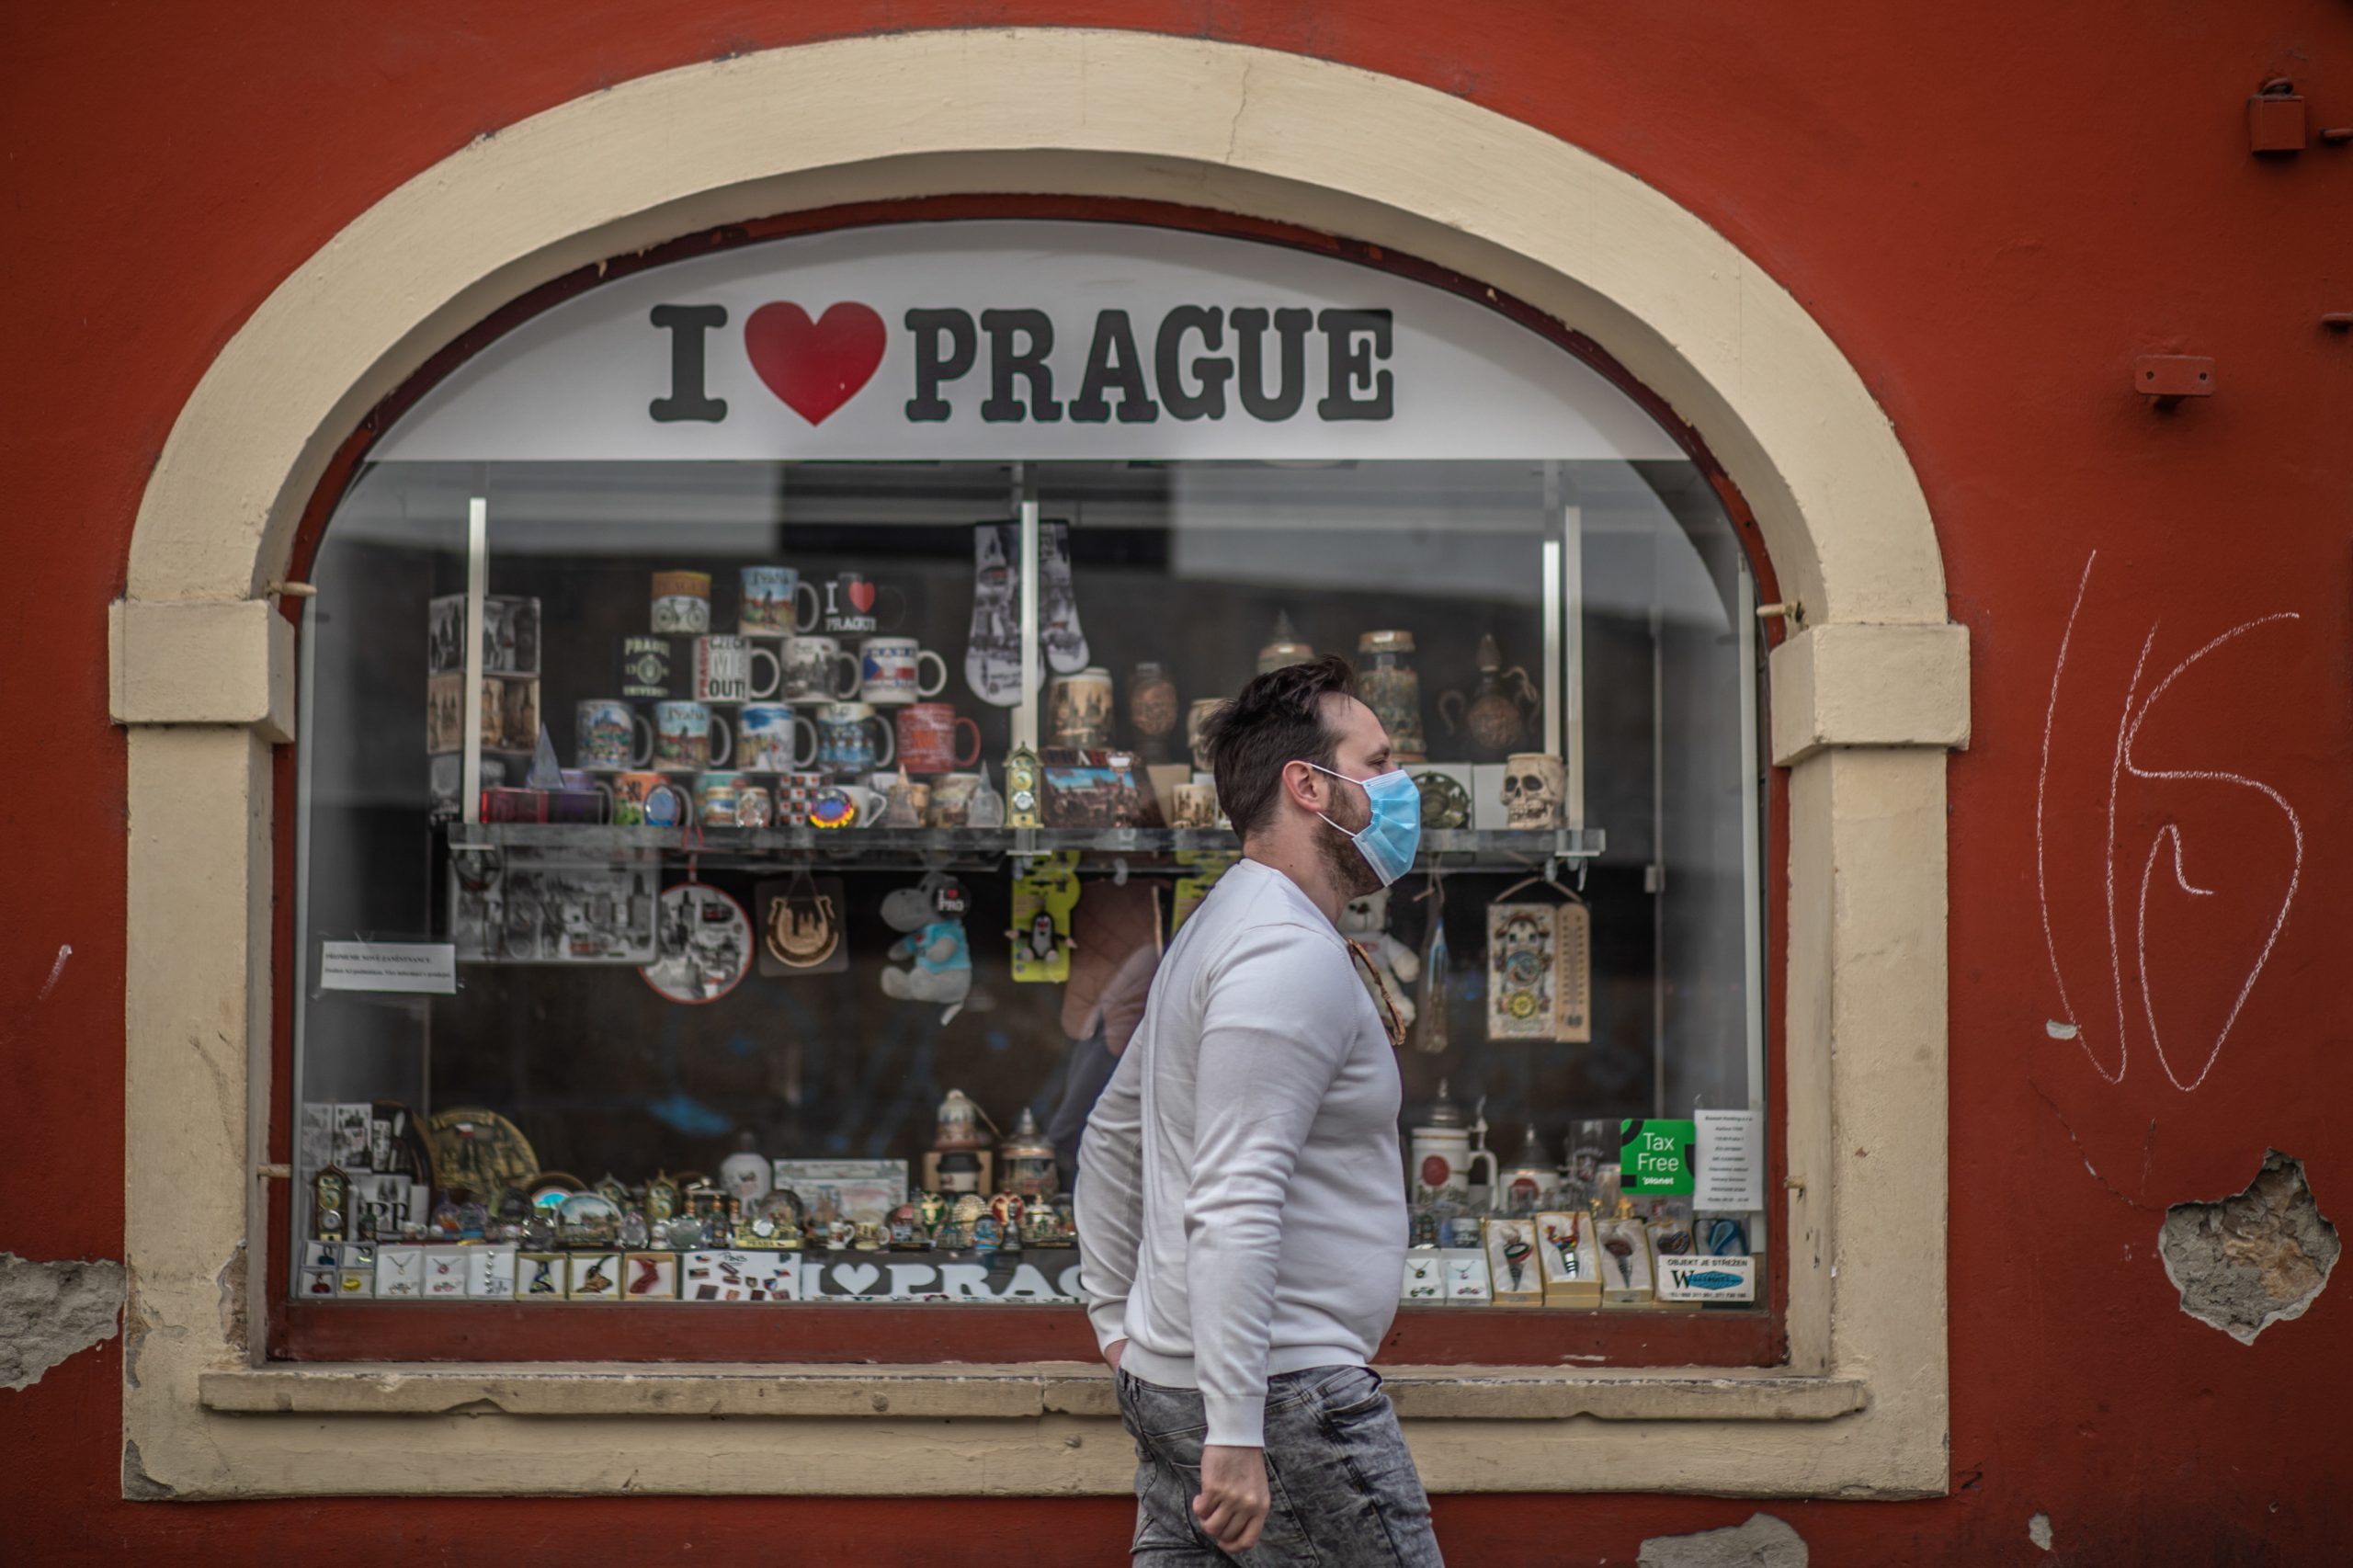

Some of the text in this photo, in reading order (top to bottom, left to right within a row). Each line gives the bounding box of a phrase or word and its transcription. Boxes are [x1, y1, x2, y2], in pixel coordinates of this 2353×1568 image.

[649, 304, 1394, 424] I PRAGUE
[1643, 1132, 1675, 1151] Tax
[1638, 1153, 1679, 1172] Free
